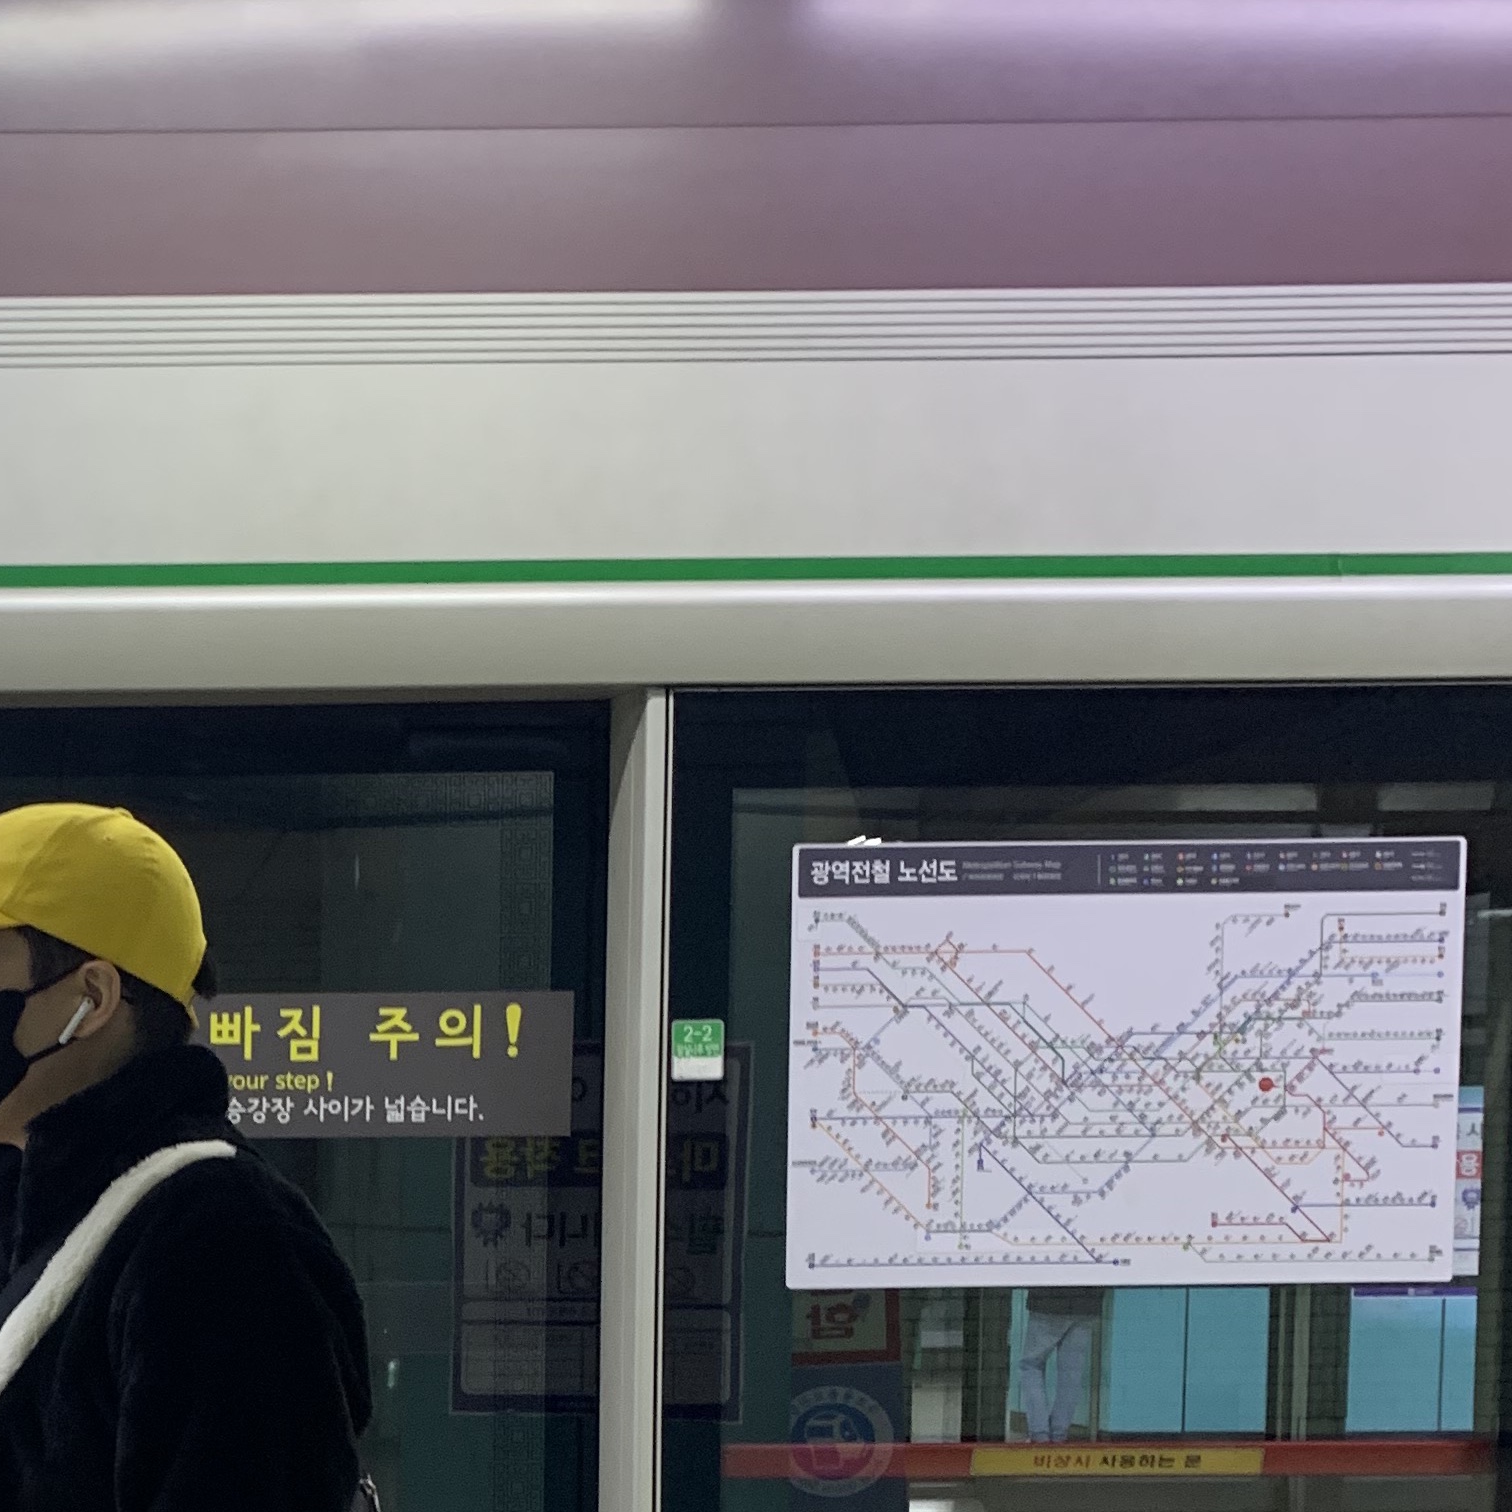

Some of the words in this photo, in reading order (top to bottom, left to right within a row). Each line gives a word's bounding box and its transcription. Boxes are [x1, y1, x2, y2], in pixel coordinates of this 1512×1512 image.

[810, 859, 891, 885] 광역전철
[897, 859, 958, 884] 노선도
[683, 1024, 713, 1043] 2-2
[303, 1095, 375, 1124] 사이가
[384, 1095, 485, 1124] 넓습니다.
[1032, 1453, 1091, 1469] 비상시
[1098, 1453, 1176, 1469] 사용하는
[1183, 1453, 1202, 1469] 문
